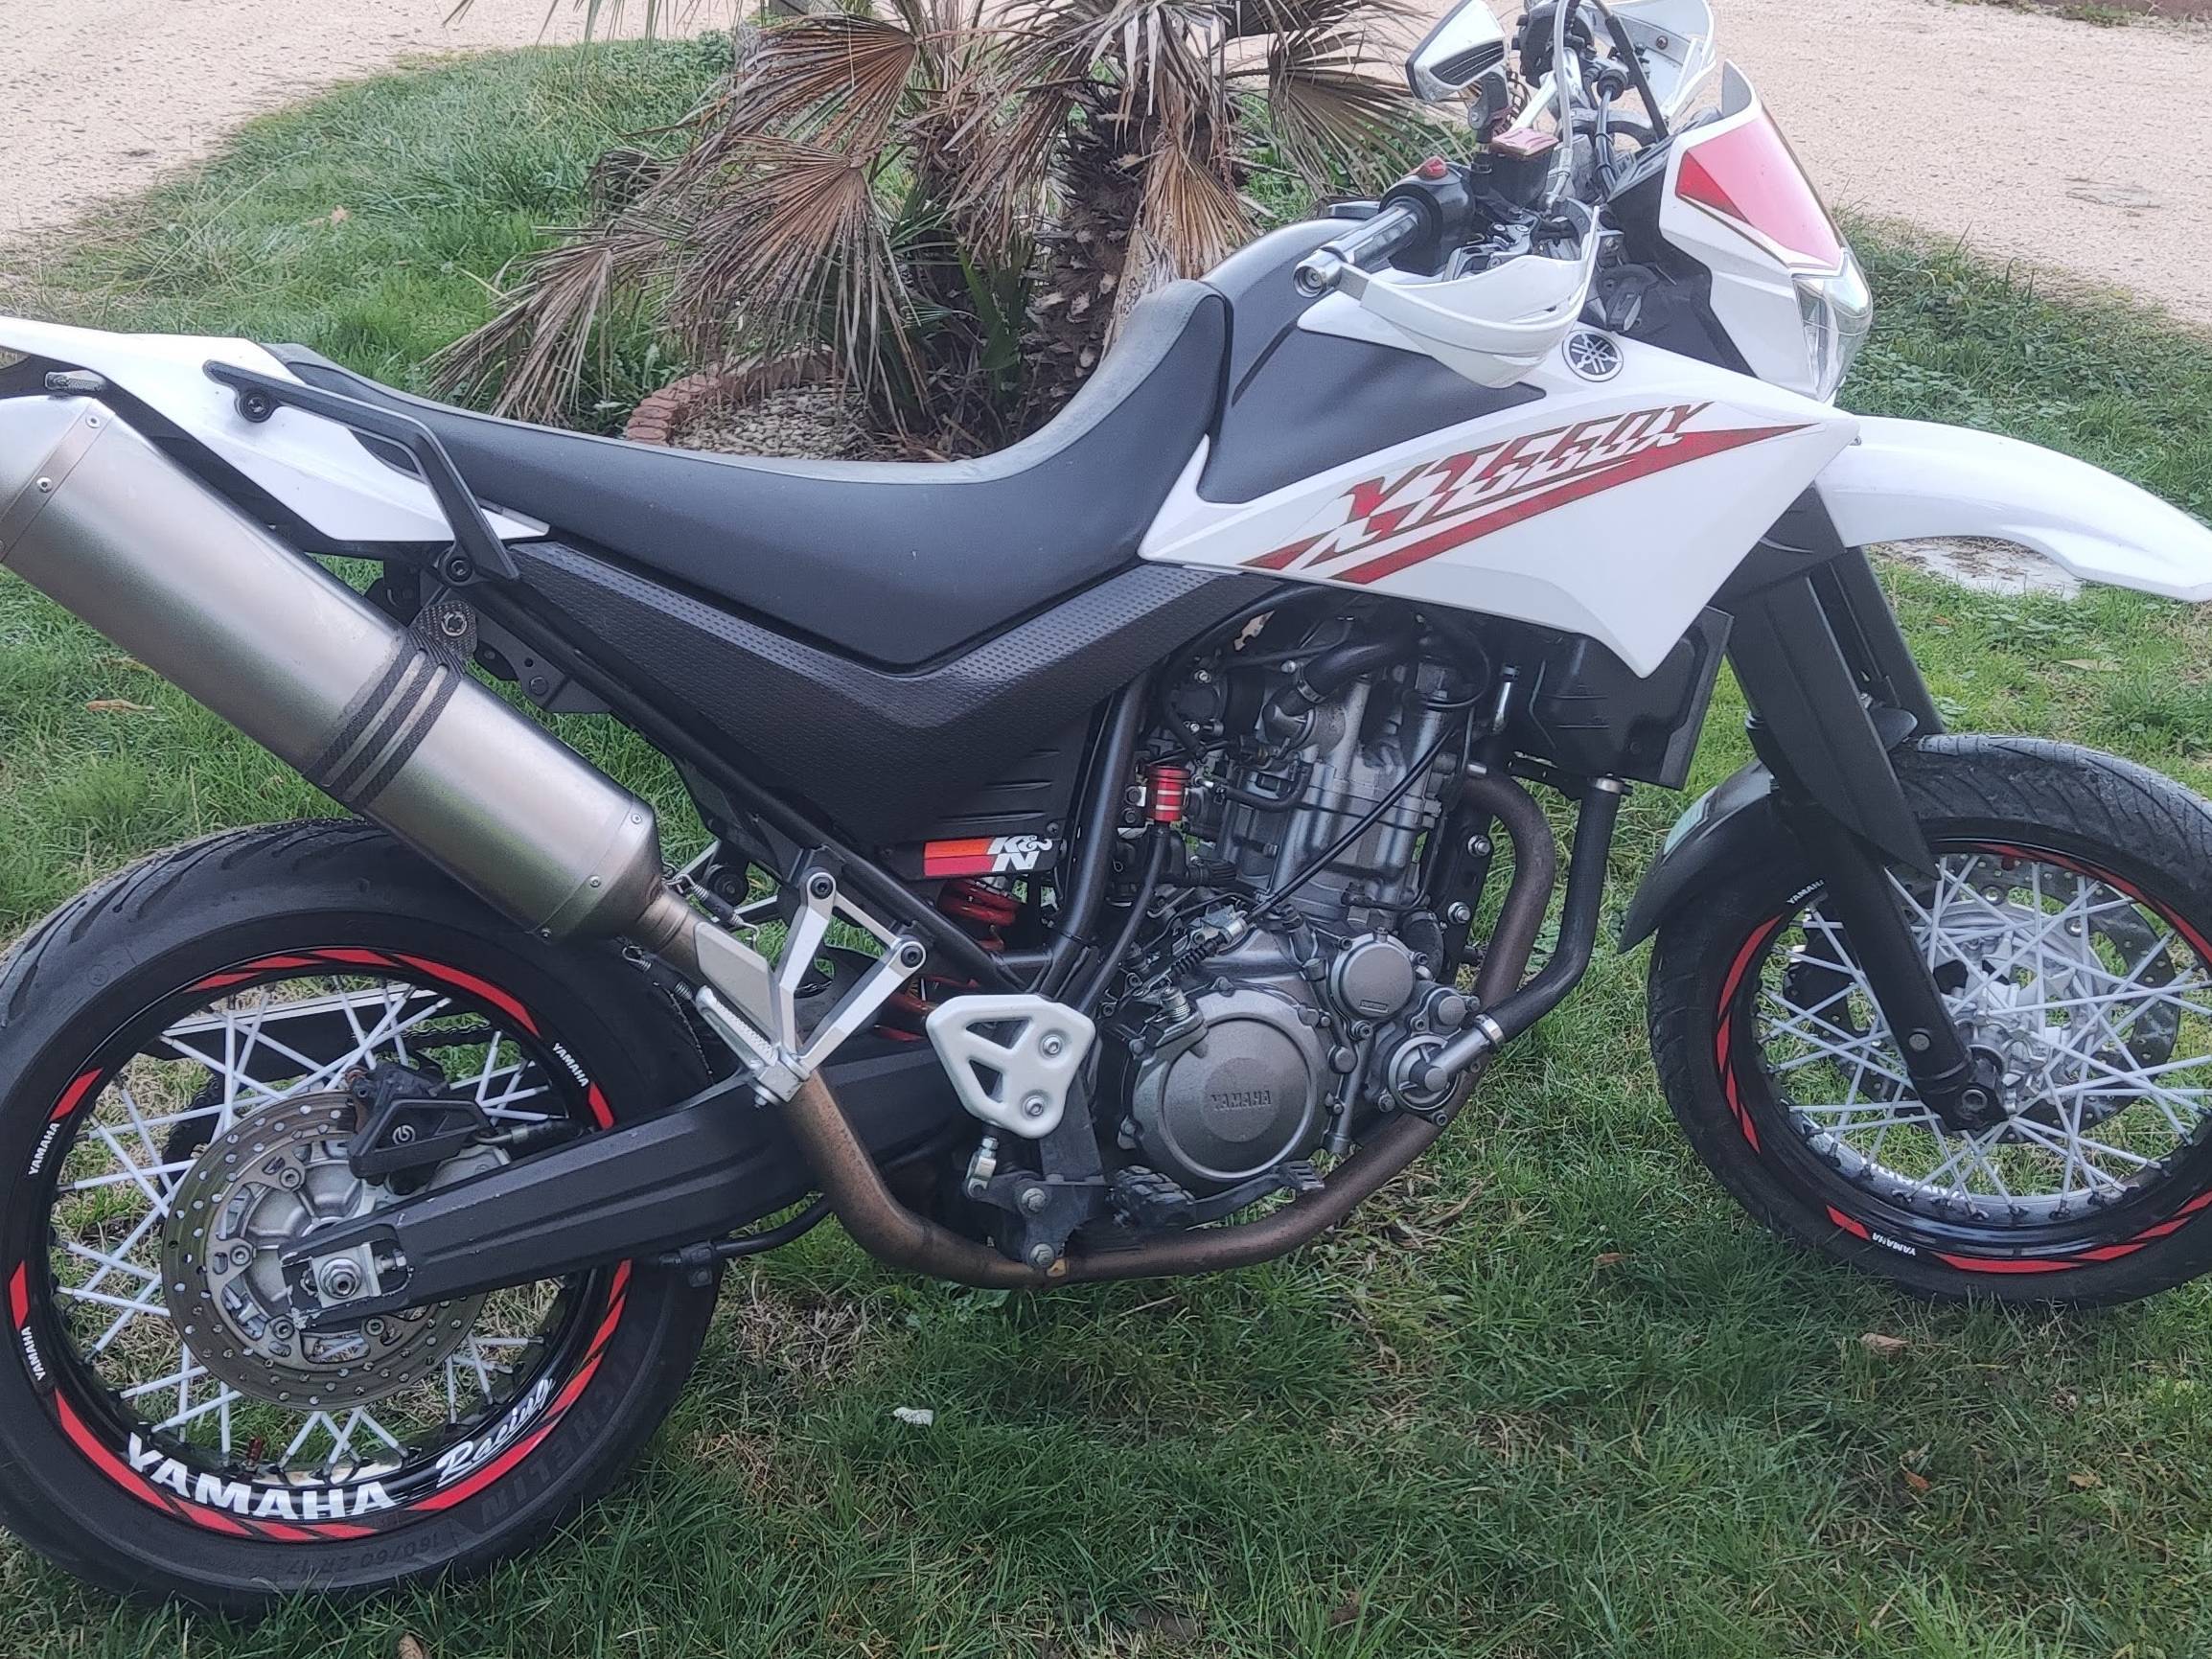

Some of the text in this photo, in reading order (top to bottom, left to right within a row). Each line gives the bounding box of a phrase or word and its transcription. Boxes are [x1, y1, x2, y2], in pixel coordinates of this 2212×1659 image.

[552, 1043, 589, 1088] YAMAHA
[1210, 1090, 1273, 1112] YAMAHA
[28, 1122, 60, 1175] YAMAHA
[1872, 1232, 1916, 1256] YAMAHA
[21, 1325, 46, 1381] YAMAHA
[128, 1378, 556, 1520] YAMAHA Racing
